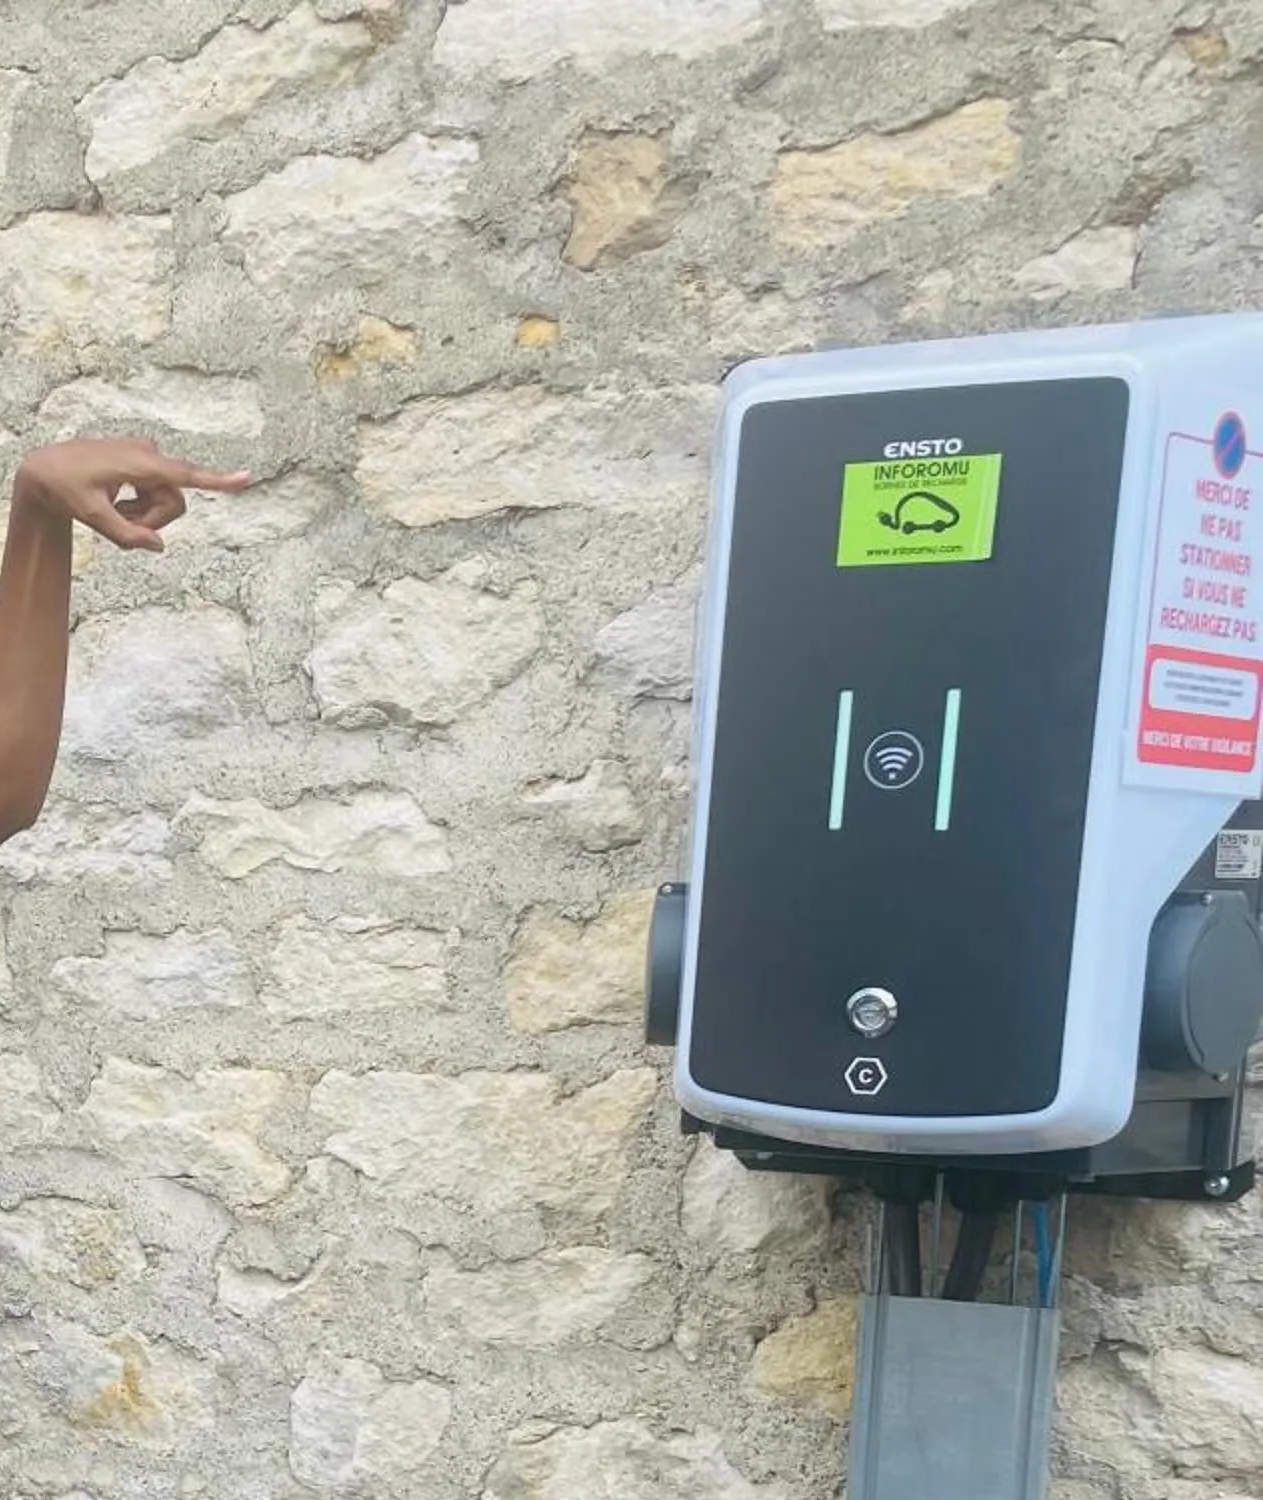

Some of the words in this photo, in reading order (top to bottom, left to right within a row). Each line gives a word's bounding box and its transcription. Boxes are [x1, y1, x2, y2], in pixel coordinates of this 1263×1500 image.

[883, 437, 963, 458] ENSTO
[874, 461, 970, 480] INFOROMU
[908, 479, 921, 489] DE
[1196, 480, 1232, 506] MERCI
[1234, 487, 1251, 510] DE
[1200, 513, 1217, 536] NE
[1218, 517, 1242, 542] PAS
[1180, 543, 1250, 575] STATIONNER
[1183, 577, 1195, 600] SI
[1196, 580, 1229, 605] VOUS
[1230, 586, 1246, 609] NE
[1160, 607, 1230, 639] RECHARGEZ
[1233, 617, 1257, 643] PAS
[858, 1067, 874, 1084] C
